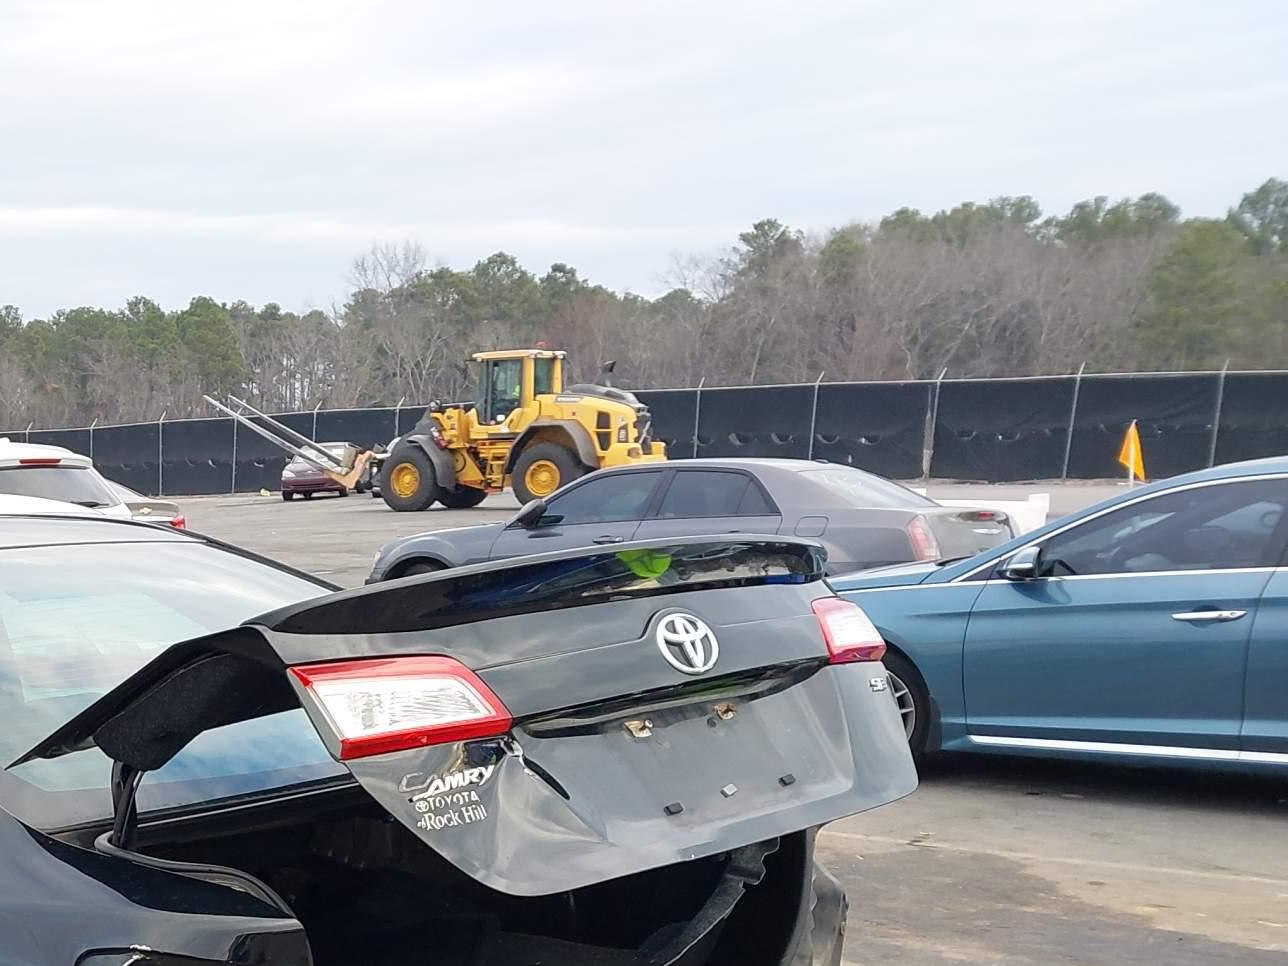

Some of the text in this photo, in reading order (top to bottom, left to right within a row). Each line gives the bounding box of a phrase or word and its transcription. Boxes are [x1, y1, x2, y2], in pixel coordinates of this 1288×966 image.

[399, 765, 495, 803] CAMRY
[427, 790, 481, 810] TOYOTA
[424, 810, 464, 831] Rock
[461, 804, 488, 824] Hill
